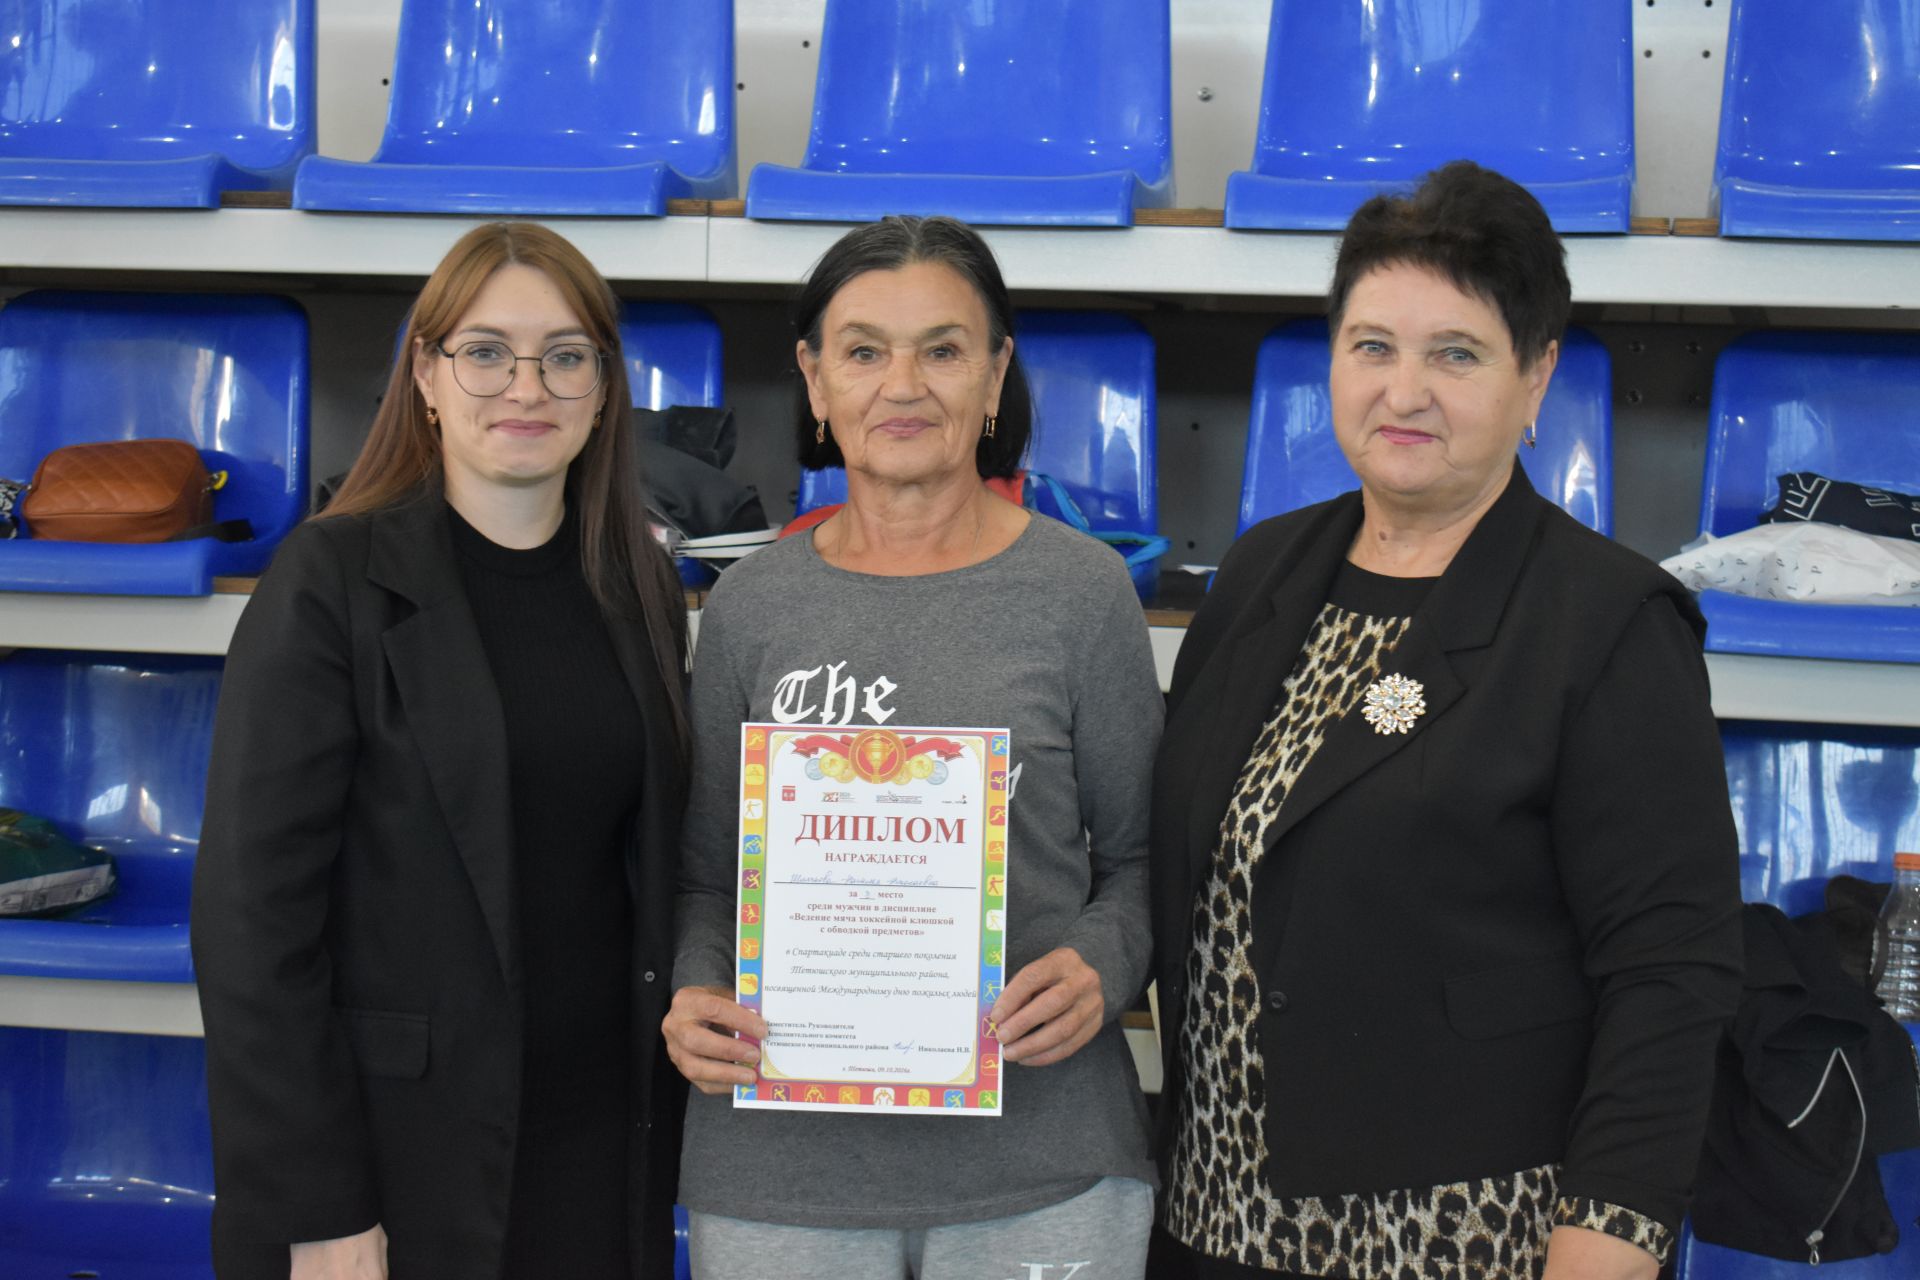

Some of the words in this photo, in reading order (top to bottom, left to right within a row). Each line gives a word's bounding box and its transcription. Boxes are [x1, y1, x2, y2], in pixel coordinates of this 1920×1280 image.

[772, 660, 898, 725] The
[795, 814, 967, 847] ДИПЛОМ
[824, 852, 928, 865] НАГРАЖДАЕТСЯ
[807, 903, 833, 911] среди
[835, 904, 872, 912] мужчин
[881, 905, 937, 913] дисциплине
[789, 912, 831, 921] «Ведение
[833, 915, 856, 923] мяча
[858, 915, 907, 924] хоккейной
[909, 916, 954, 925] клюшкой
[827, 925, 869, 934] обводкой
[872, 928, 925, 937] предметов»
[792, 948, 847, 958] Спартакиаде
[848, 948, 871, 959] среди
[873, 951, 912, 960] старшего
[914, 952, 957, 961] поколения
[791, 965, 847, 977] Тетюшского
[848, 968, 917, 978] муниципального
[764, 985, 816, 995] посвященной
[817, 985, 892, 997] Международному
[892, 987, 910, 996] дню
[911, 989, 951, 999] пожилых
[951, 988, 977, 998] людей
